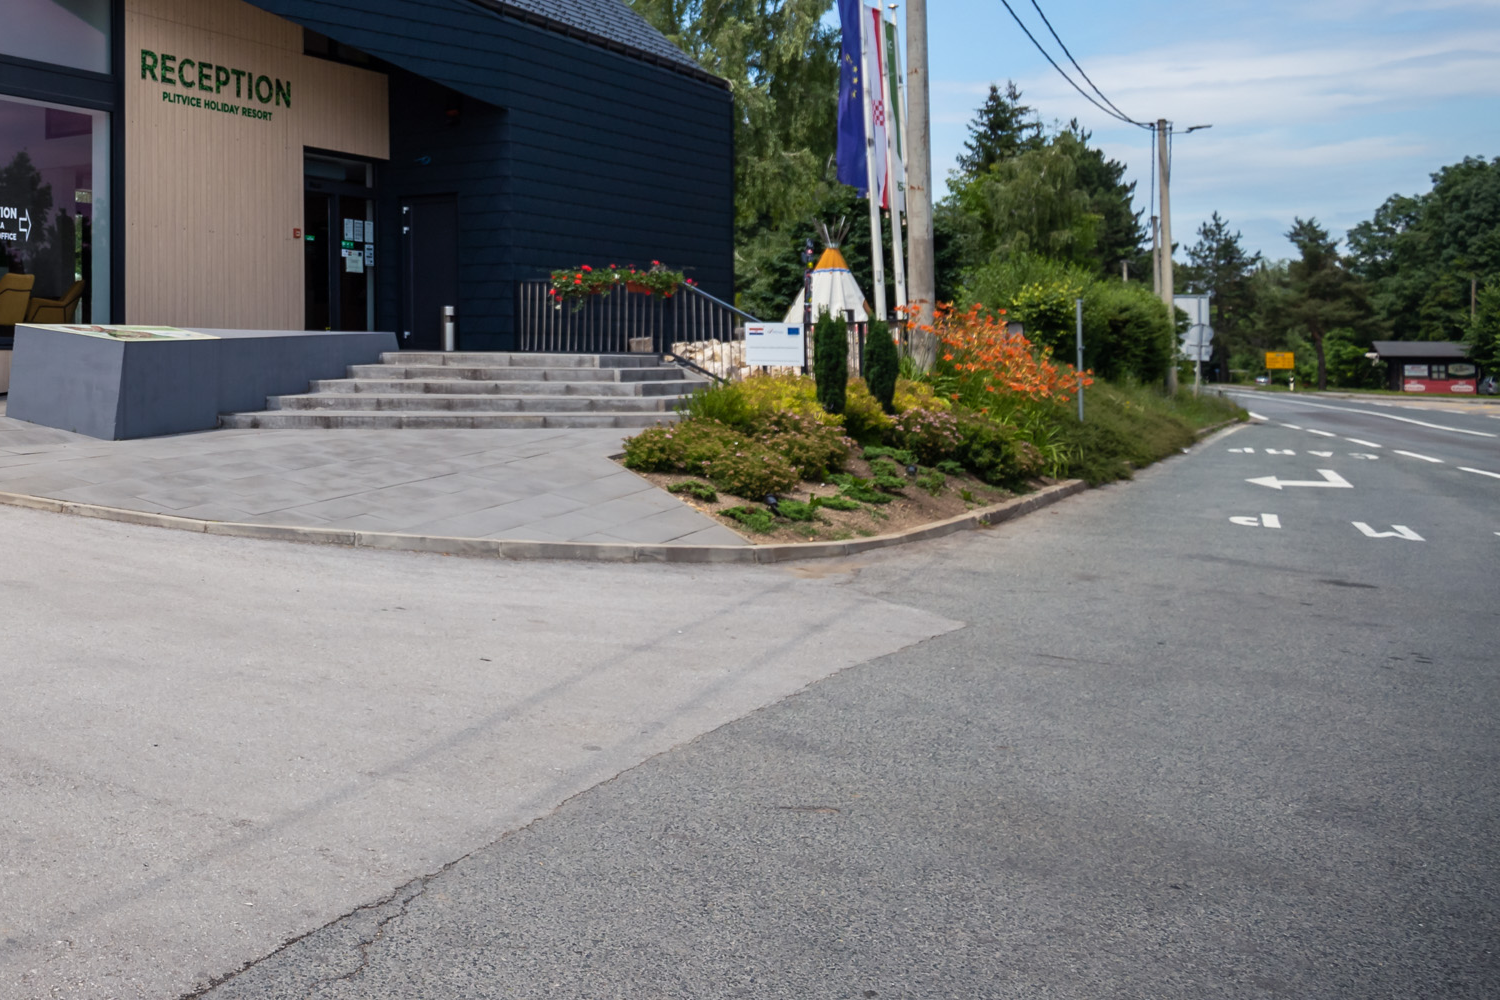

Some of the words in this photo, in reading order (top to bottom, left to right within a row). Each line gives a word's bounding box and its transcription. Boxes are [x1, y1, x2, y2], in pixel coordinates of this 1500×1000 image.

[140, 49, 291, 109] RECEPTION
[162, 91, 202, 108] PLITVICE
[204, 99, 240, 115] HOLIDAY
[242, 107, 273, 121] RESORT
